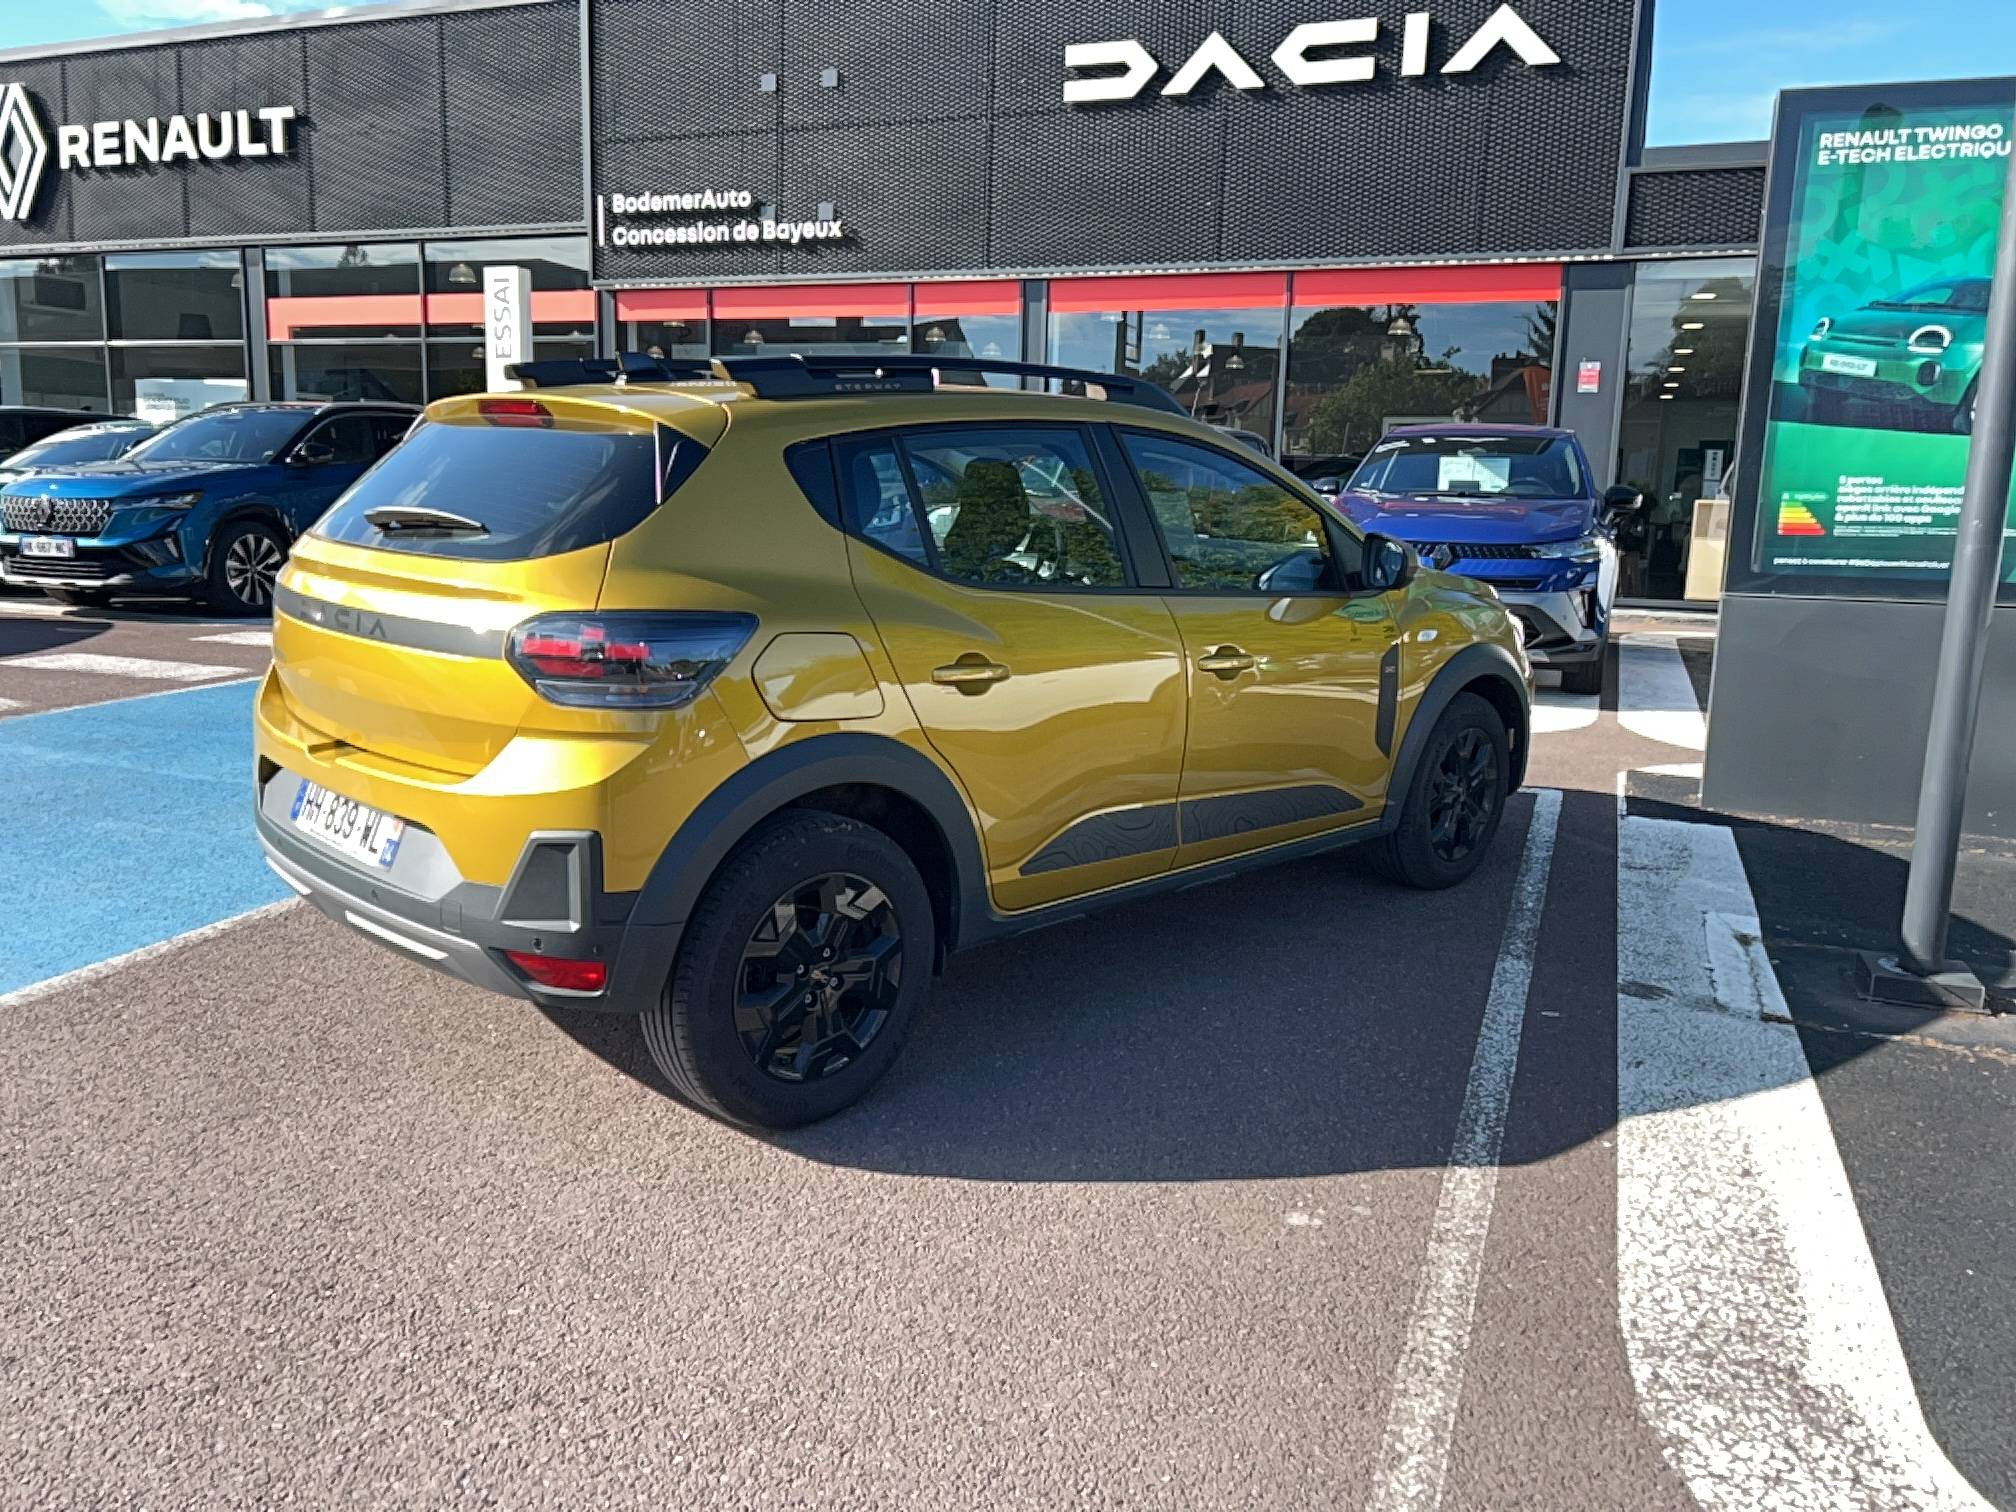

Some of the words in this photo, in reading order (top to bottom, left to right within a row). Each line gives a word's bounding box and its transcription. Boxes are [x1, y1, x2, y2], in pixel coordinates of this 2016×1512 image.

[1063, 4, 1561, 102] DACIA
[58, 105, 296, 169] RENAULT
[1820, 128, 1912, 149] RENAULT
[1914, 123, 2003, 143] TWINGO
[1818, 146, 1891, 165] E-TECH
[1895, 140, 2012, 161] ELECTRIQU
[612, 189, 751, 213] BodemerAuto
[612, 220, 730, 246] Concession
[732, 220, 760, 240] de
[762, 220, 842, 244] Bayeux
[494, 278, 511, 358] ESSAI
